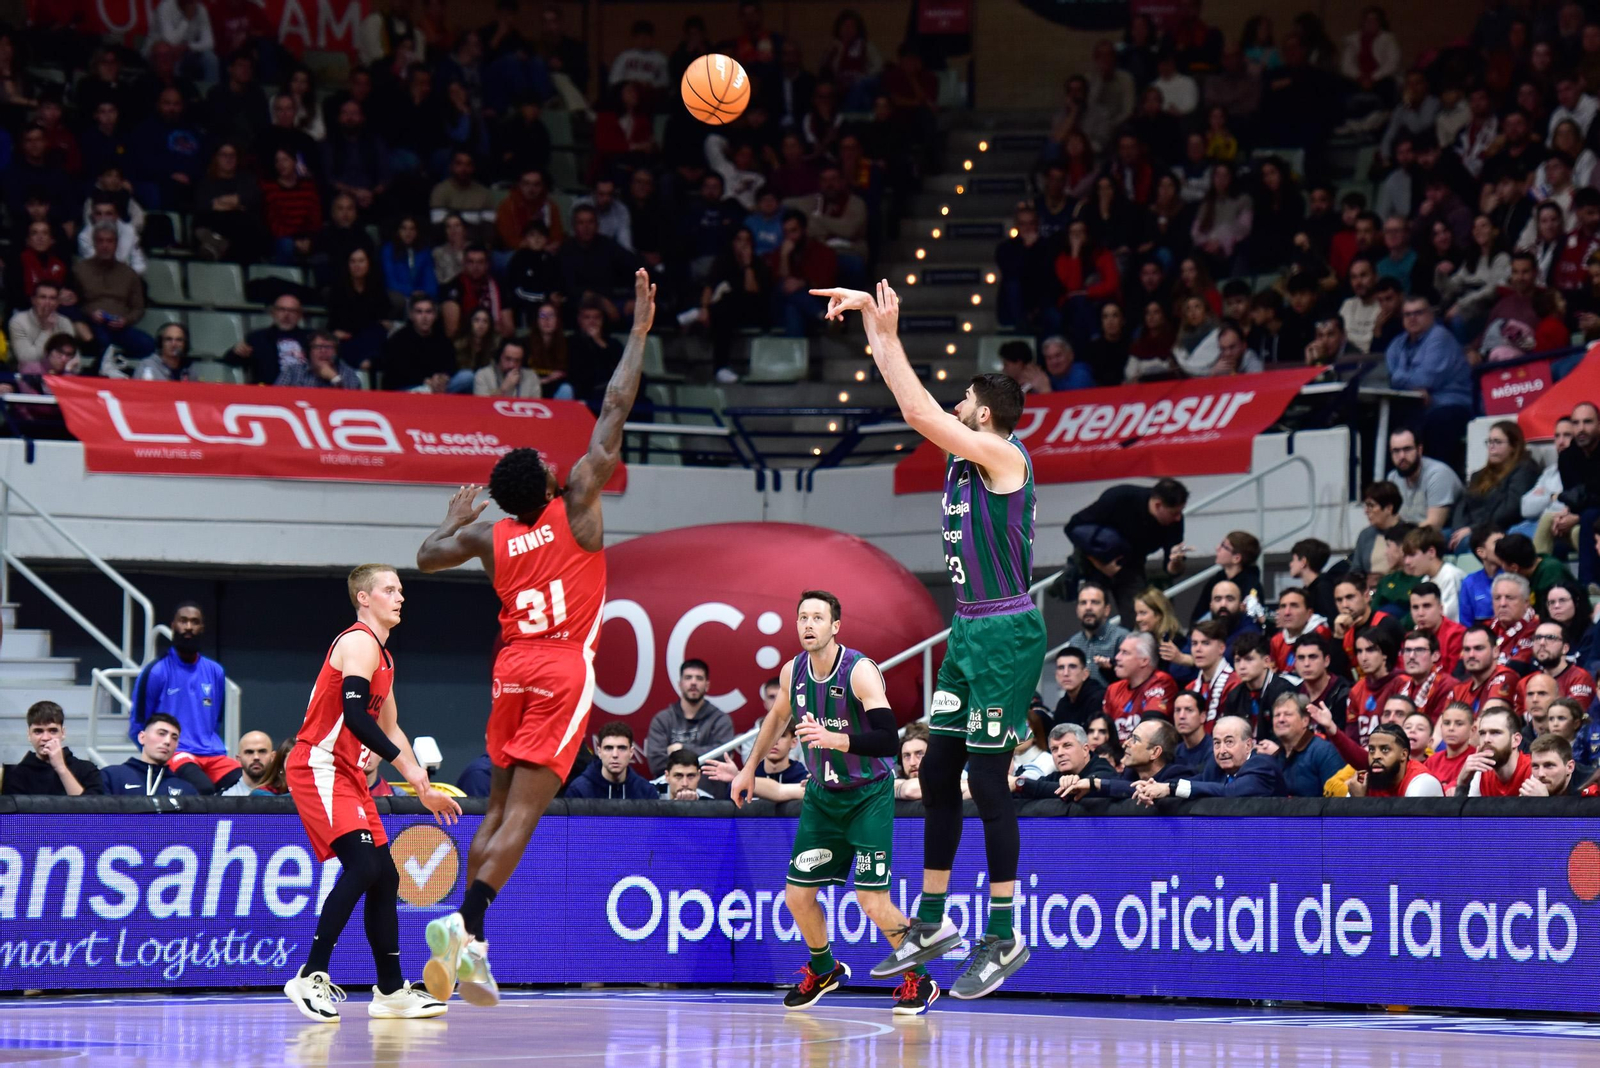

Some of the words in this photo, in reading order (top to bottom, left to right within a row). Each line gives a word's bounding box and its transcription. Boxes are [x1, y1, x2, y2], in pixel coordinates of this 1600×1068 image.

[1491, 378, 1544, 400] MÓDULO
[1046, 391, 1256, 443] Renesur
[406, 429, 437, 444] Tu
[943, 500, 970, 517] nicaja
[507, 524, 555, 558] ENNIS
[515, 579, 567, 634] 31
[825, 761, 839, 784] 4
[606, 875, 878, 954] Operado
[899, 871, 1102, 961] lgítico
[1294, 882, 1373, 957] de
[1389, 883, 1441, 959] la
[1458, 887, 1578, 963] acb
[116, 926, 298, 980] Logistics
